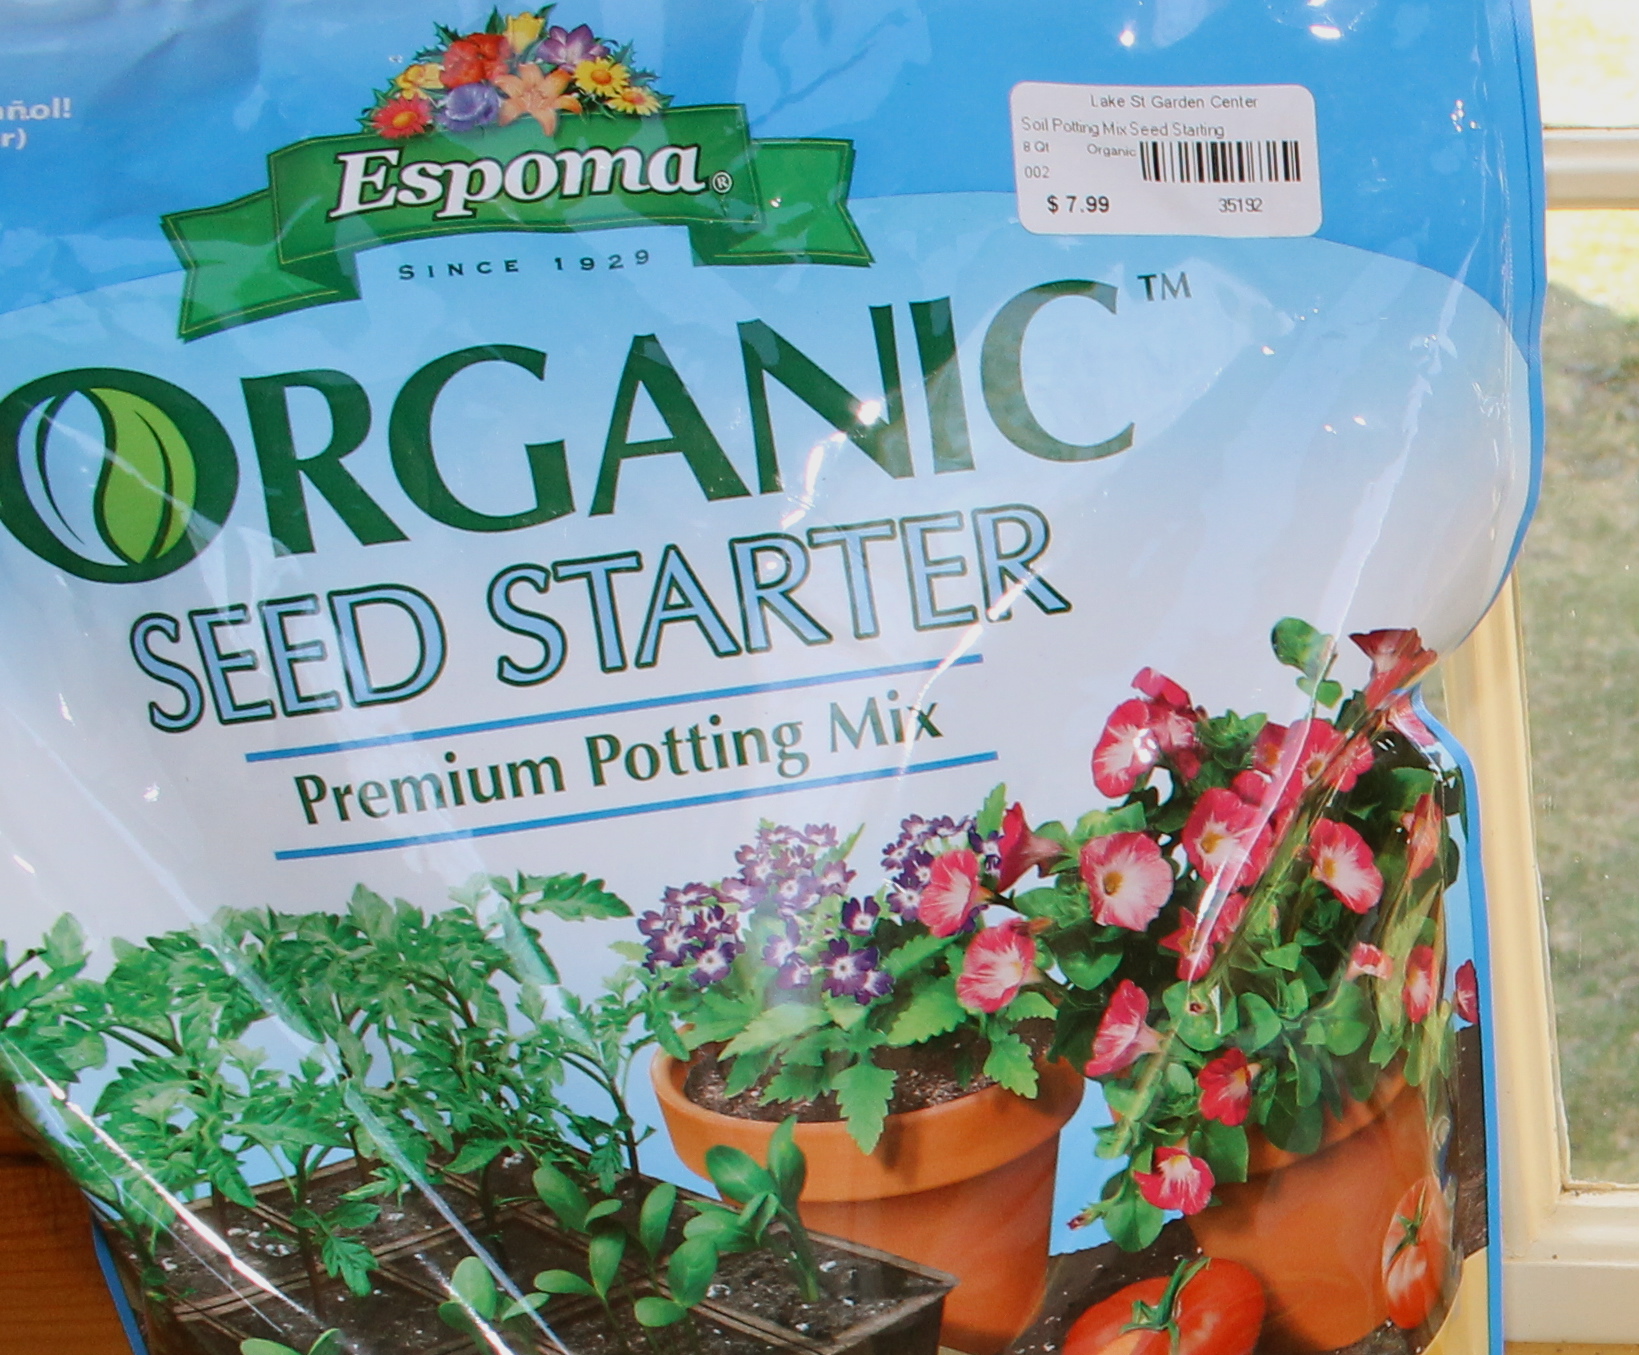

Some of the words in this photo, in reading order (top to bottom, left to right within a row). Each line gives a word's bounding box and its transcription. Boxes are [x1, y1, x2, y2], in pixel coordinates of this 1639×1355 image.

[1091, 94, 1125, 108] Lake
[1130, 95, 1145, 108] St
[1152, 95, 1204, 108] Garden
[1211, 95, 1258, 108] Center
[1022, 117, 1048, 131] Soil
[1053, 119, 1099, 136] Potting
[1103, 121, 1127, 135] Mix
[1130, 122, 1168, 136] Seed
[1172, 123, 1224, 139] Starting
[1023, 141, 1031, 152] 8
[1034, 141, 1049, 154] Qt
[1087, 144, 1136, 158] Organic
[1024, 166, 1049, 178] 002
[1218, 197, 1263, 213] 35192
[400, 259, 519, 280] SINCE
[555, 249, 649, 271] 1929
[0, 281, 1136, 583] ORGANIC
[130, 583, 448, 735] SEED
[484, 504, 1072, 686] STARTER
[294, 749, 564, 827] Premium
[584, 713, 806, 788] Potting
[828, 689, 943, 751] Mix
